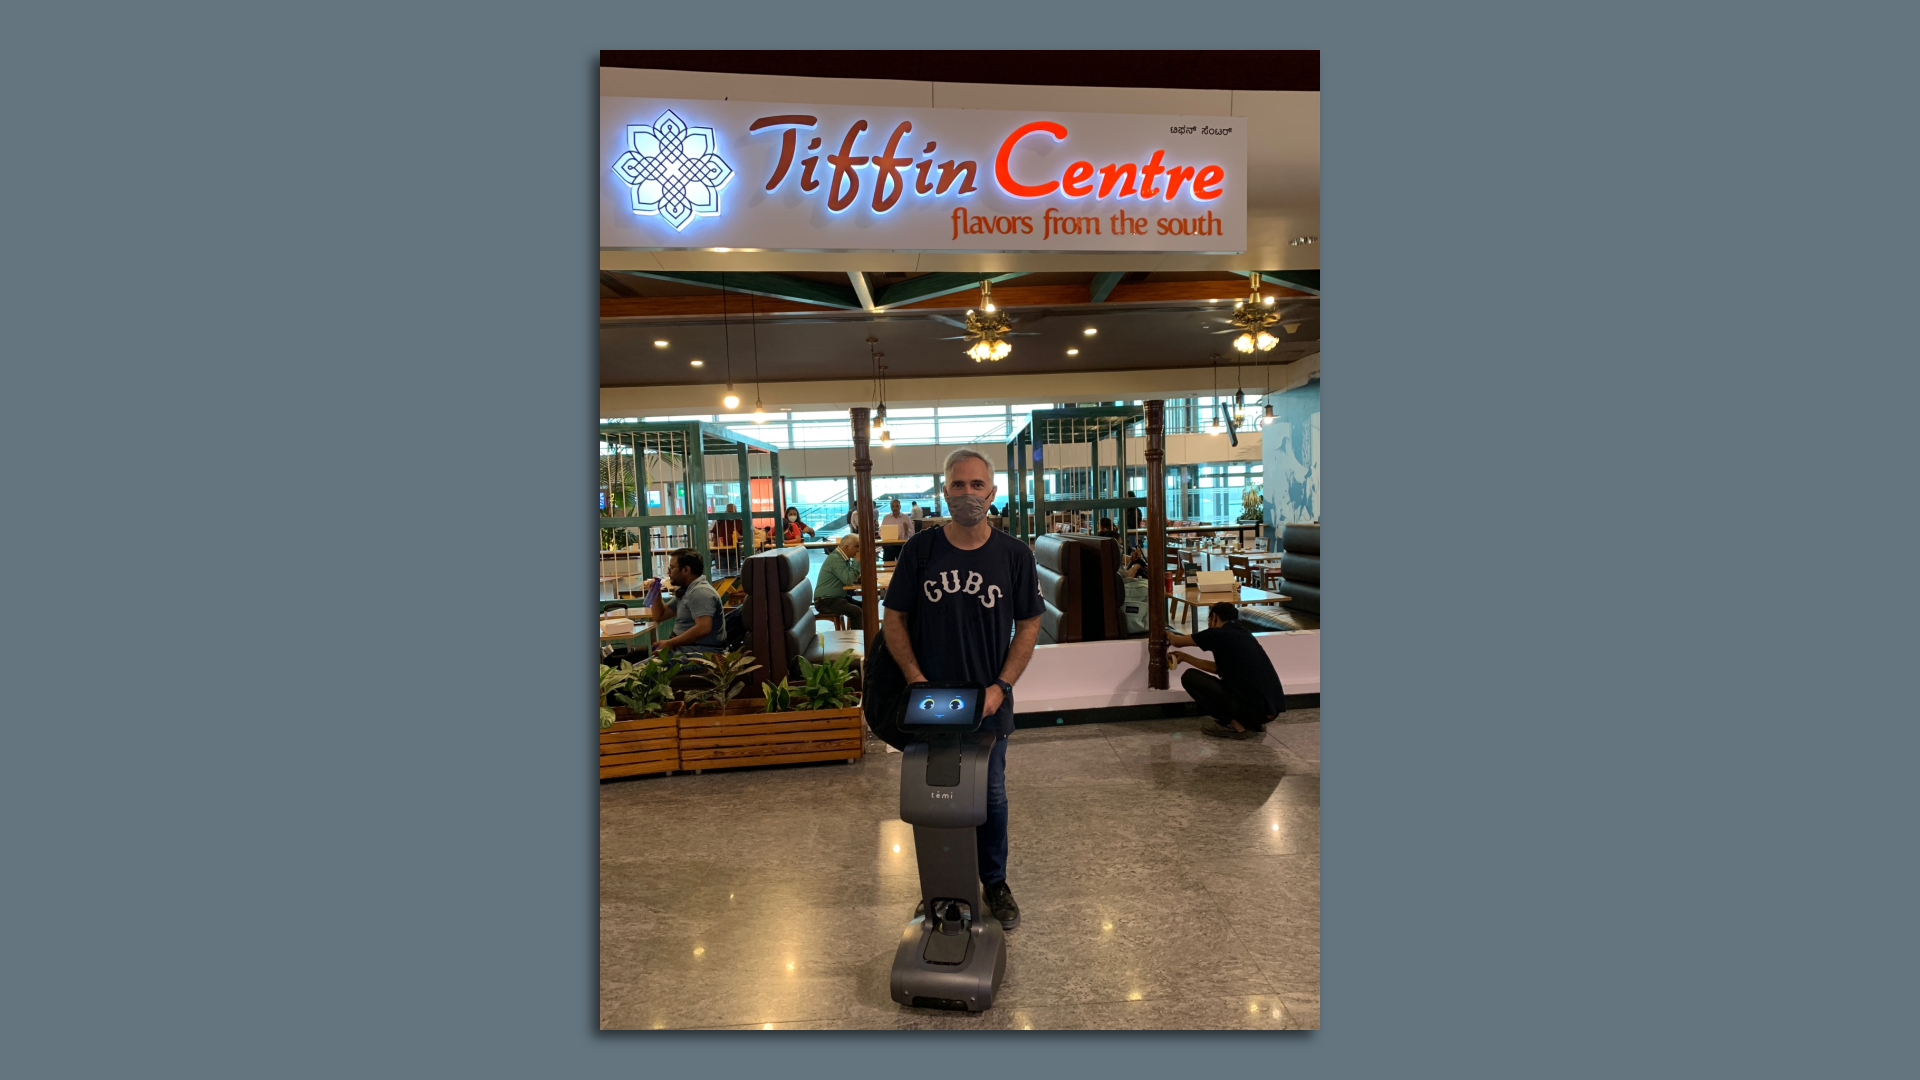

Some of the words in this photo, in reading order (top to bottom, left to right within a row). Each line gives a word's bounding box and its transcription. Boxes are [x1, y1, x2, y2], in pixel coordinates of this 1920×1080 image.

[749, 115, 977, 212] Tiffin
[995, 121, 1225, 200] Centre
[951, 207, 1033, 240] flavors
[1042, 208, 1102, 240] from
[1110, 209, 1148, 235] the
[1157, 210, 1224, 236] south
[923, 569, 1003, 608] CUBS
